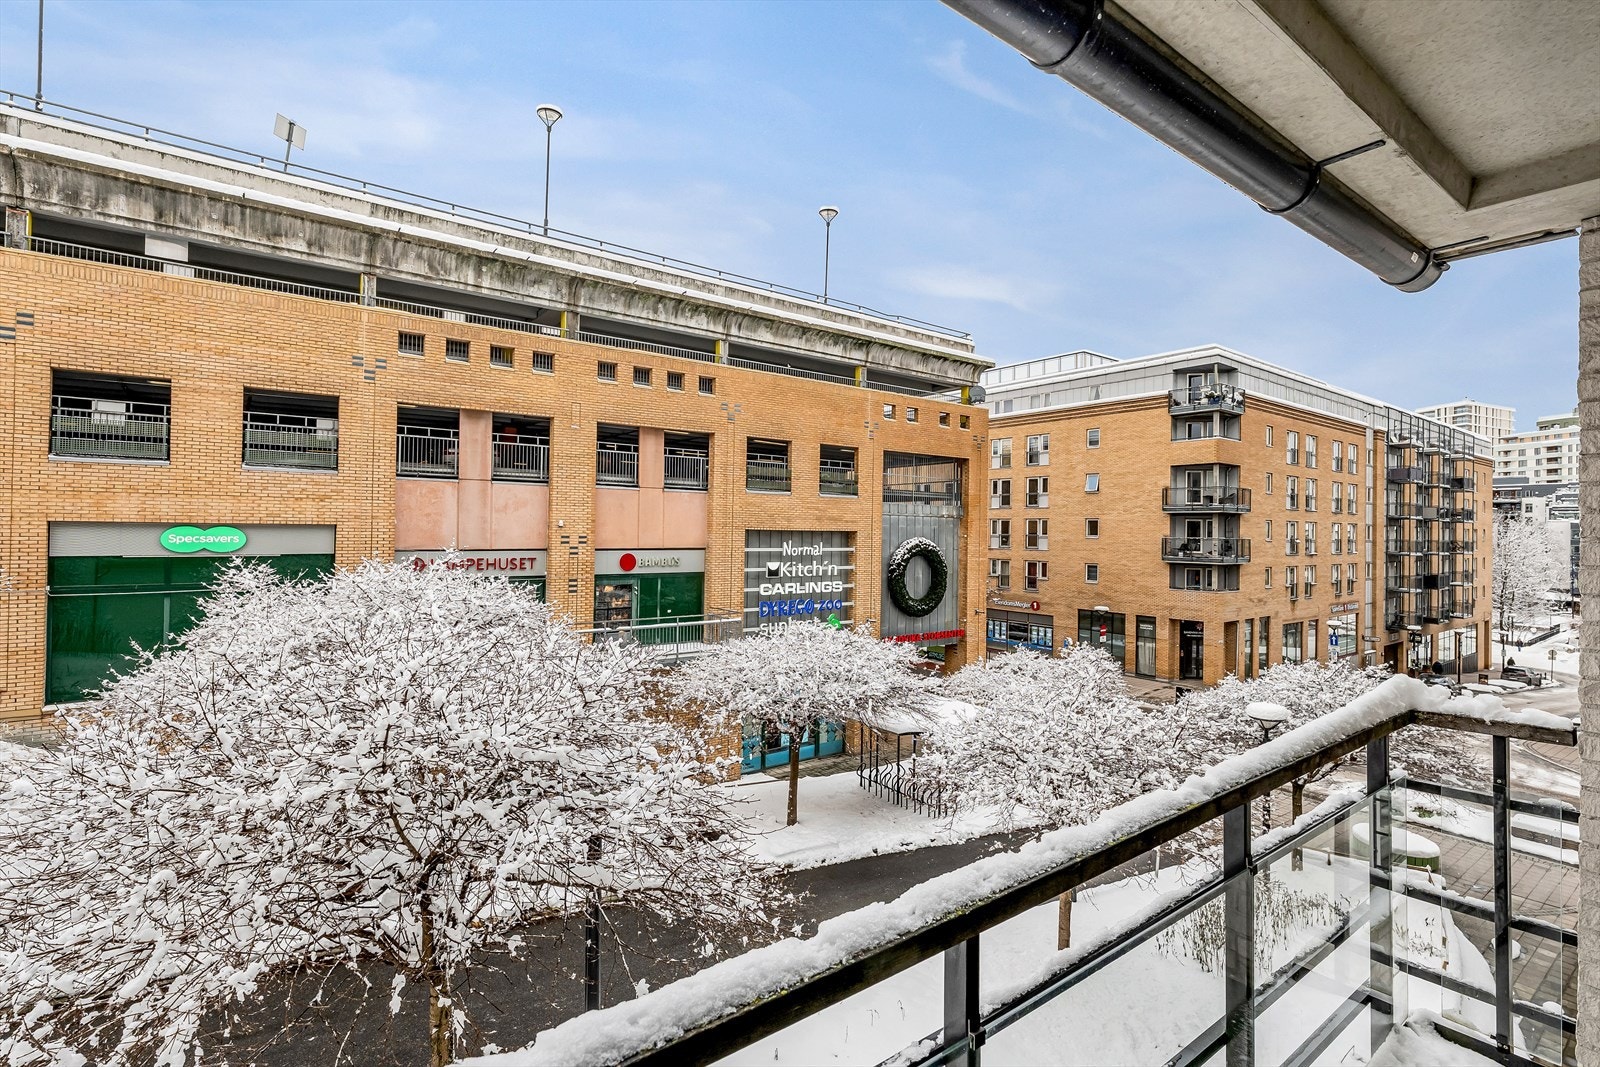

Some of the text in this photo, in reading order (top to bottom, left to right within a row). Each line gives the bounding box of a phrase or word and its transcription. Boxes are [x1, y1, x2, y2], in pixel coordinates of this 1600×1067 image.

[168, 534, 240, 545] Specsavers
[782, 540, 823, 556] Normal
[430, 557, 537, 572] MPEHUSET
[760, 581, 843, 596] CARLINGS
